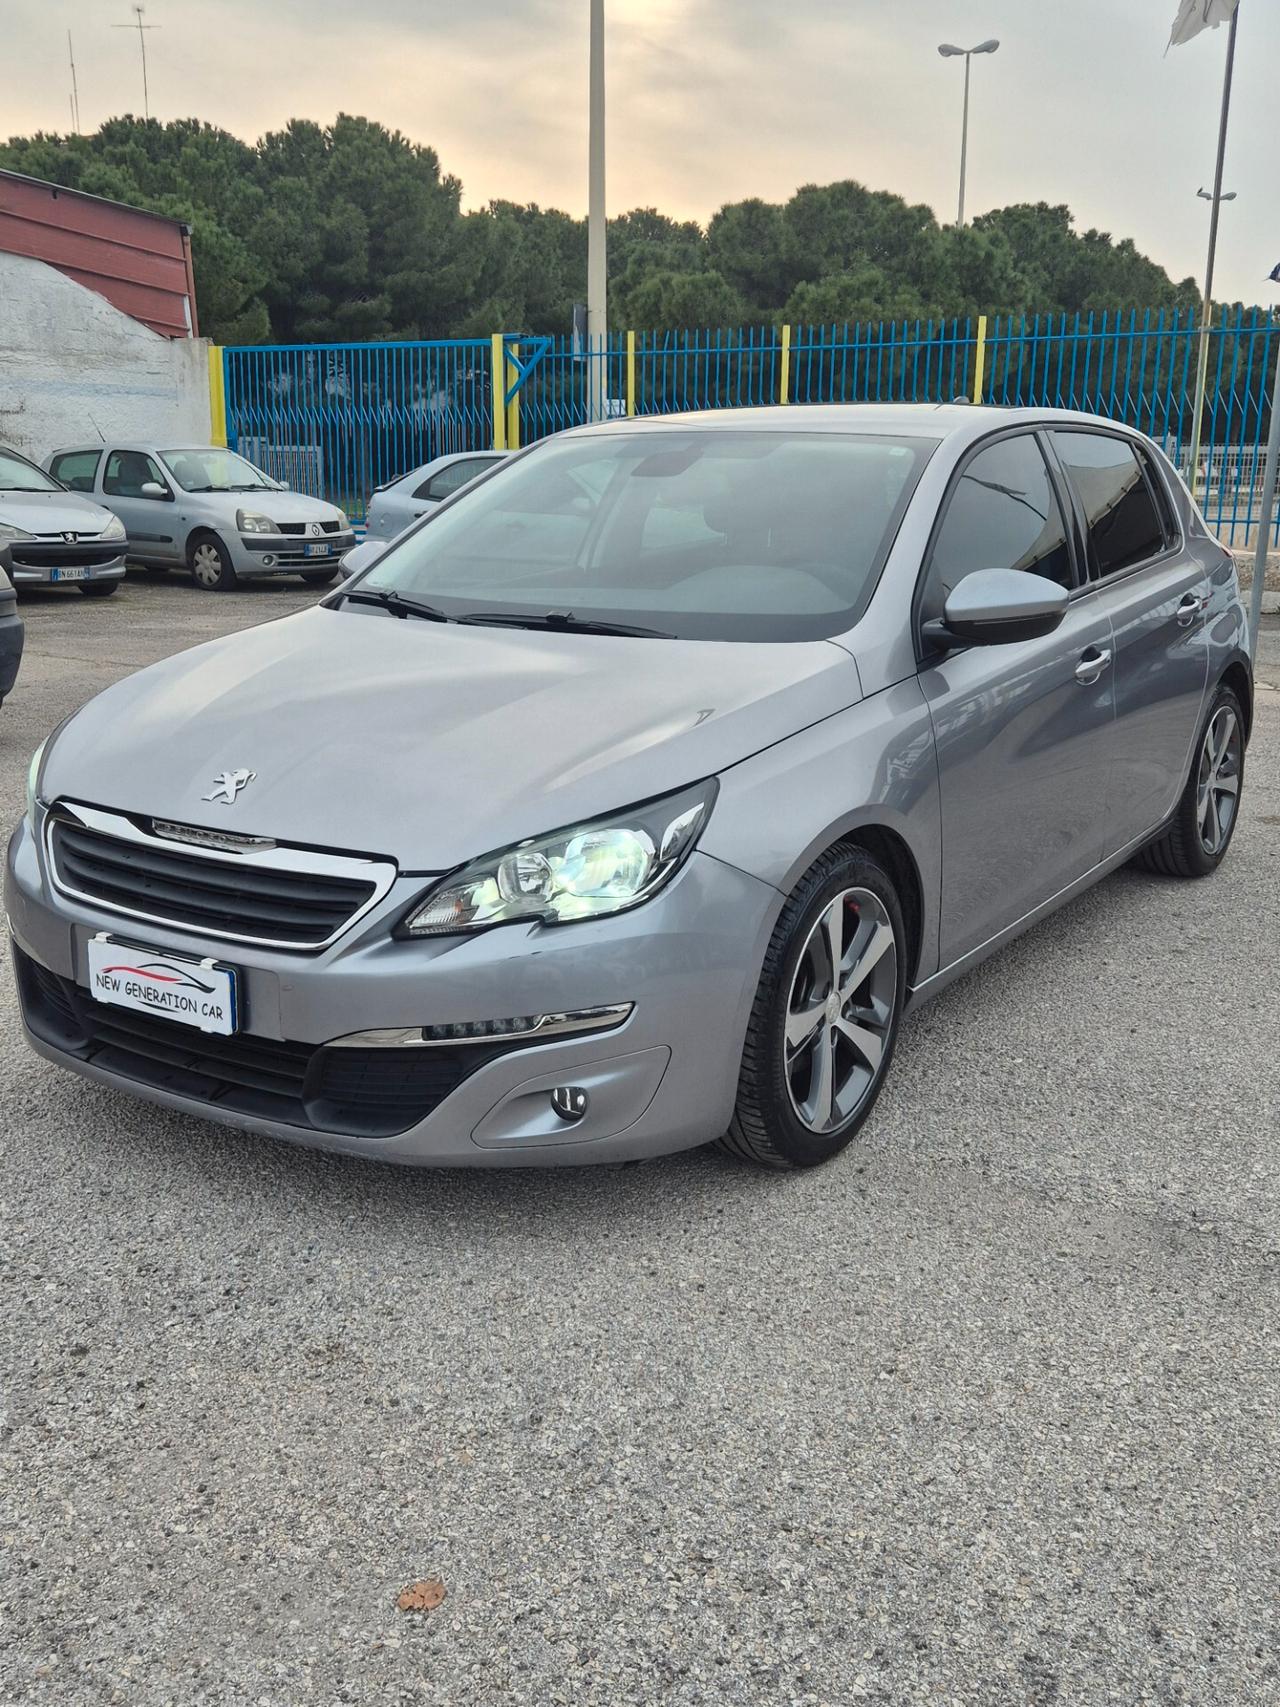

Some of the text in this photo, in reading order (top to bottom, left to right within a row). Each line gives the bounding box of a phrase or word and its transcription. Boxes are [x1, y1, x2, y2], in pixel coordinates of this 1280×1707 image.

[96, 973, 223, 1020] NEW GENERATION CAR
